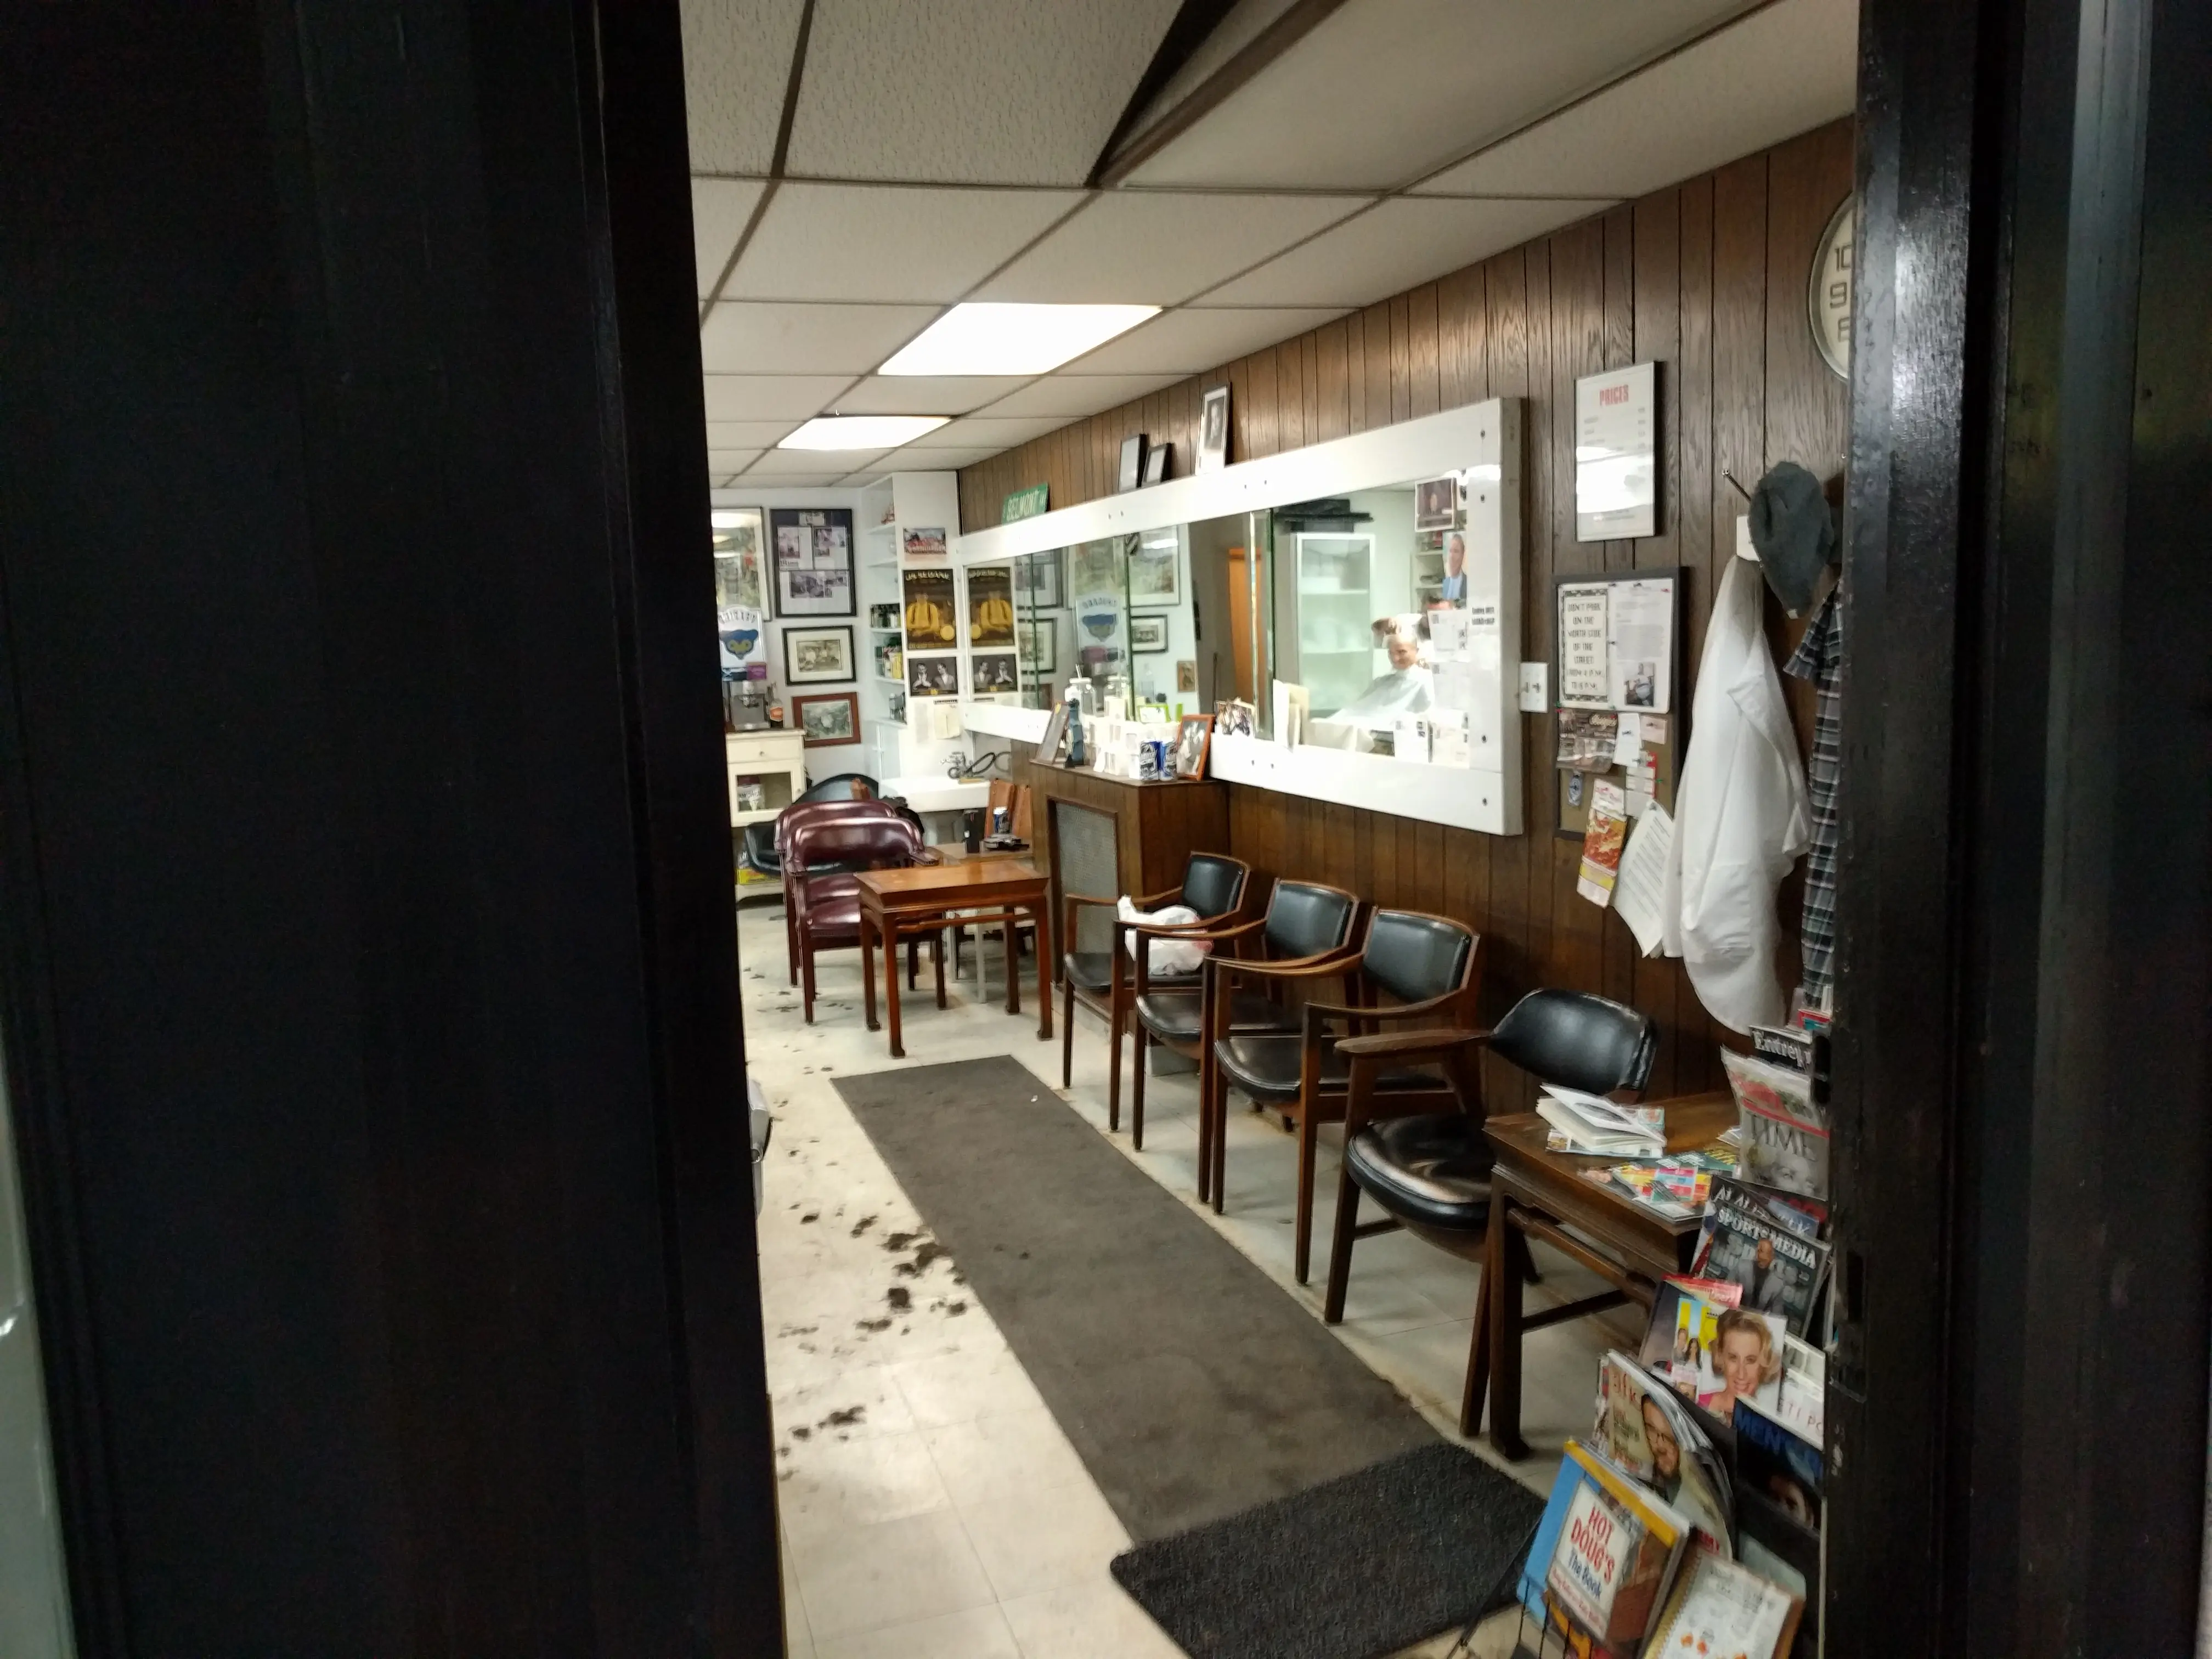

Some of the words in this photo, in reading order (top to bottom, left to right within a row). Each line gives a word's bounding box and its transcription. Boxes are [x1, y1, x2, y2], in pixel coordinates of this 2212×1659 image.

[1830, 282, 1847, 309] 9
[1599, 385, 1629, 407] PRICES
[1769, 1229, 1816, 1270] MEDIA
[1588, 1505, 1614, 1545] HOT
